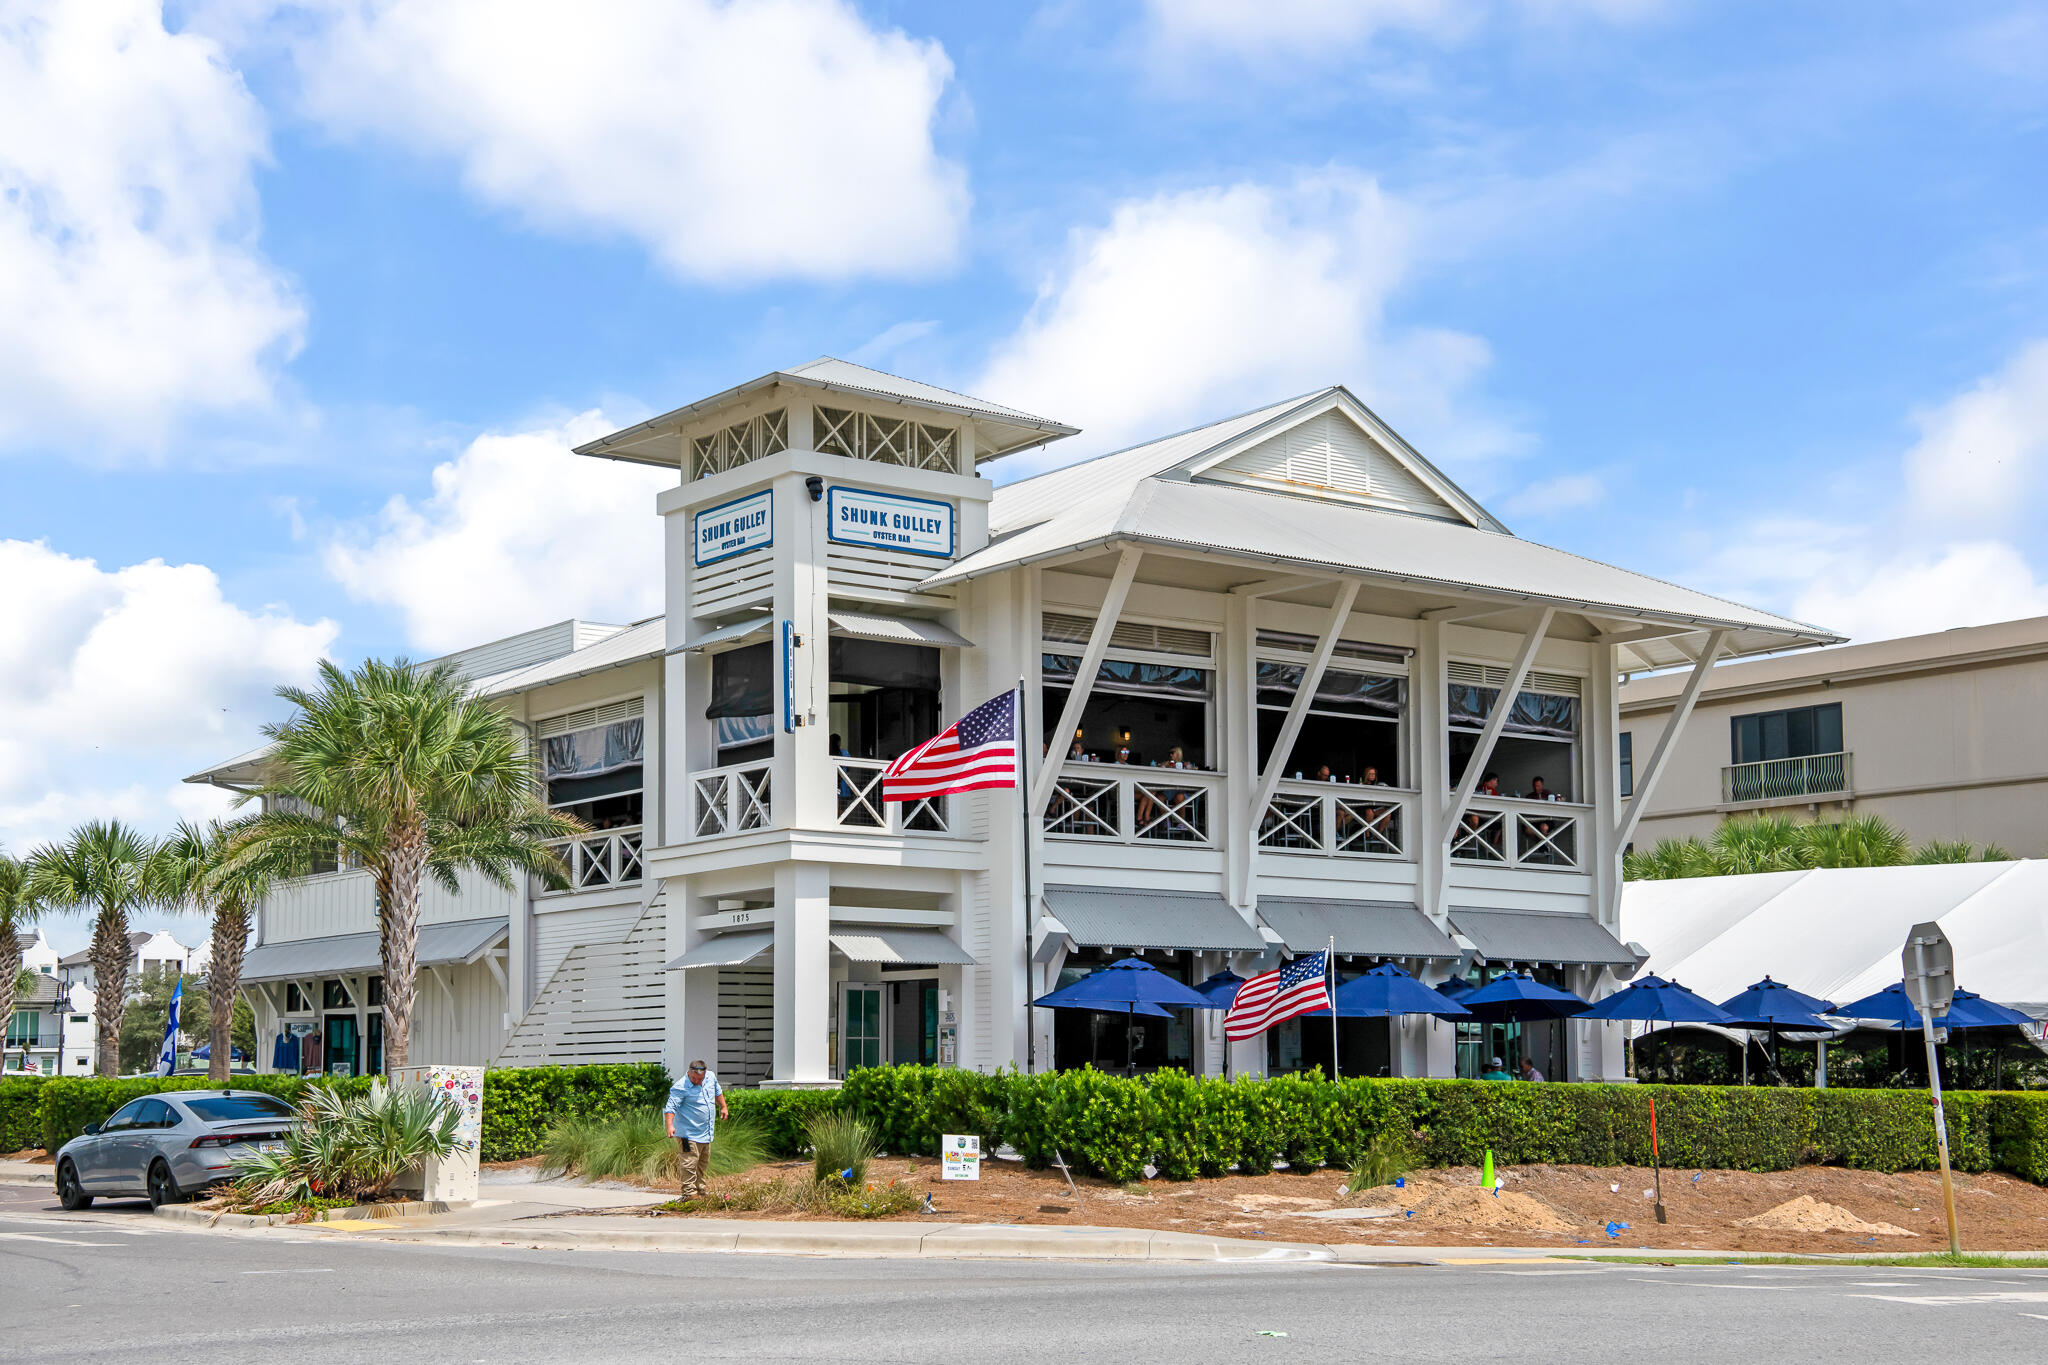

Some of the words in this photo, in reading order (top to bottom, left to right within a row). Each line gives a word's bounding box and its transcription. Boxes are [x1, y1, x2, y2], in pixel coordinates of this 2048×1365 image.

[702, 521, 731, 544] SHUNK
[734, 510, 766, 534] GULLEY
[841, 506, 888, 527] SHUNK
[893, 513, 942, 535] GULLEY
[721, 539, 736, 550] OYSTER
[737, 536, 746, 546] BAR
[873, 530, 897, 542] OYSTER
[898, 534, 911, 543] BAR
[732, 913, 750, 923] 1875
